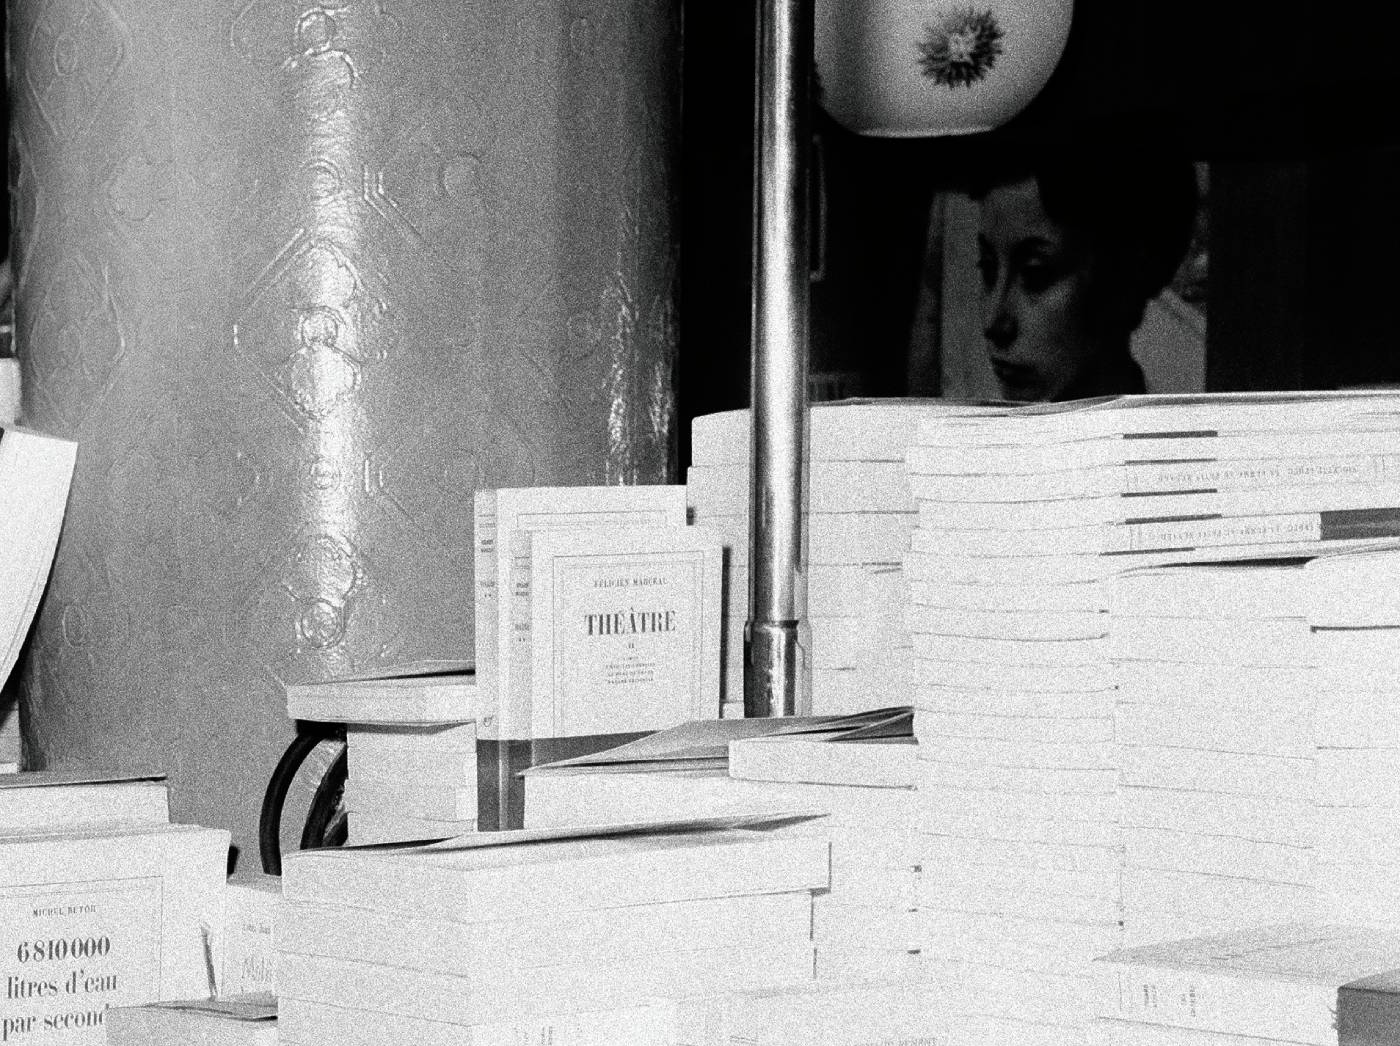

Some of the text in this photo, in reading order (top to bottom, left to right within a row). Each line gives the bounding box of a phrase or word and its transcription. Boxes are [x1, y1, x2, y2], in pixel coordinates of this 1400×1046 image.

[584, 606, 676, 636] THÉÂTRE
[7, 969, 117, 999] litres d'eau
[2, 1015, 37, 1042] par
